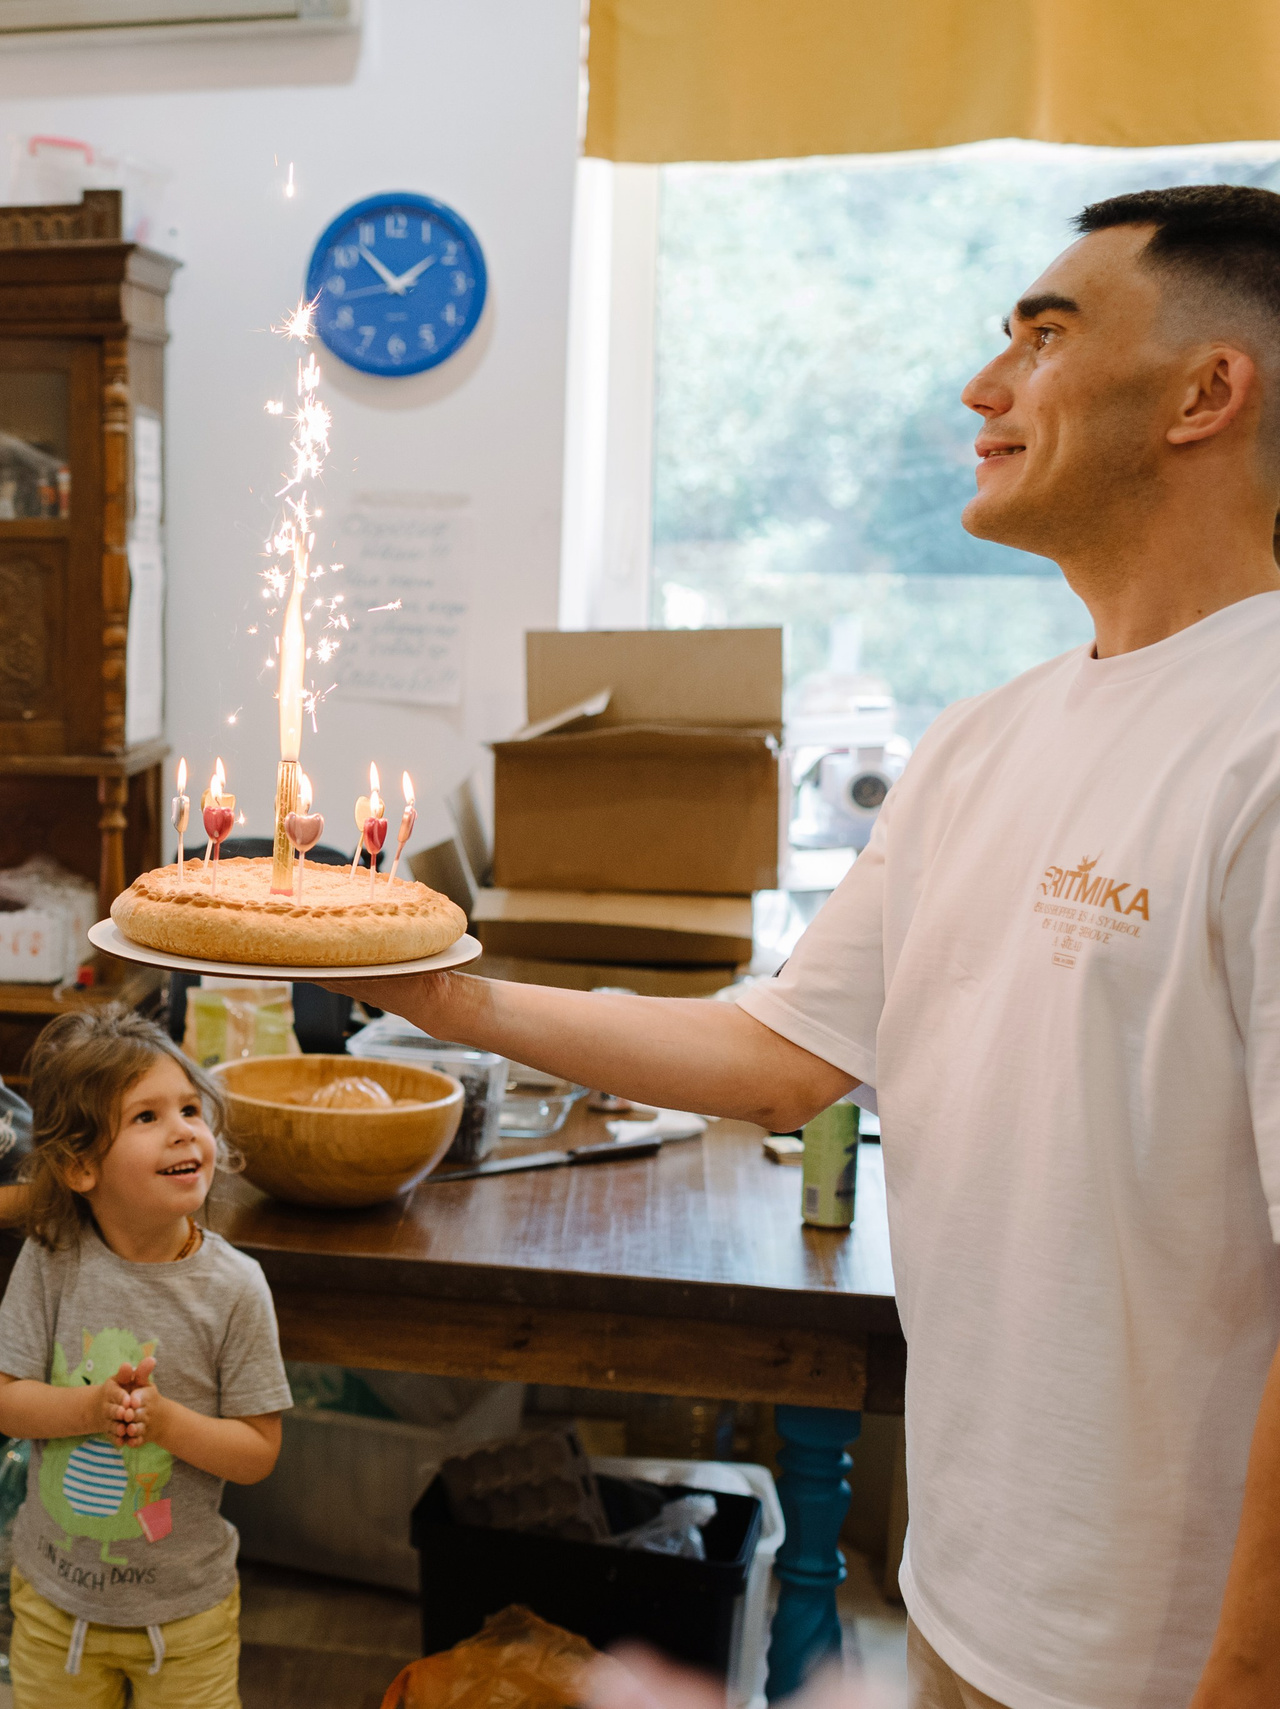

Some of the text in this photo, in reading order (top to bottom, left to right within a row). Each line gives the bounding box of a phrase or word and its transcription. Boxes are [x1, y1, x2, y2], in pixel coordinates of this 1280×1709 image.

[385, 213, 408, 238] 12
[421, 220, 431, 244] 1
[334, 244, 359, 270] 10
[440, 240, 458, 266] 2
[327, 275, 346, 296] 9
[451, 270, 467, 296] 3
[336, 305, 355, 331] 8
[441, 302, 457, 327] 4
[359, 325, 377, 349] 7
[387, 334, 406, 356] 6
[418, 324, 435, 348] 5
[1038, 865, 1150, 921] RITMIKA
[1078, 925, 1112, 944] ABOVE
[1096, 915, 1142, 938] SYMBOL
[58, 1557, 106, 1592] BEACH
[110, 1567, 157, 1585] DAYS
